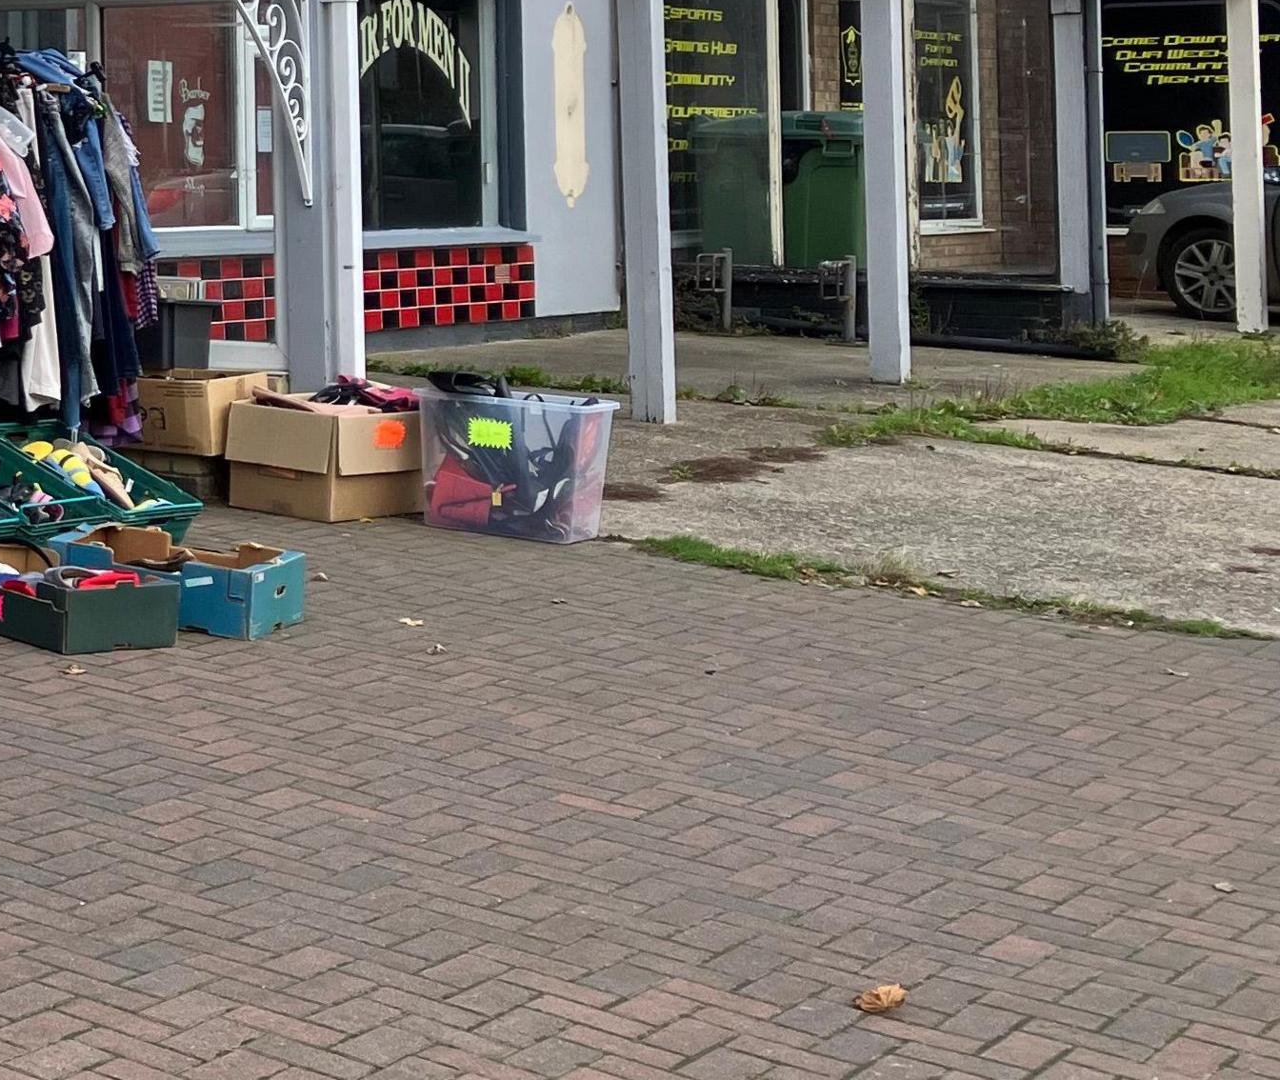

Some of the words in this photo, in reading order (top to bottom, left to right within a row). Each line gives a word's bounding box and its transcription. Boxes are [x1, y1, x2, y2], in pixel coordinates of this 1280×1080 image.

[416, 1, 456, 90] MEN
[458, 47, 472, 130] II
[1123, 61, 1230, 73] COMMUNI
[178, 76, 211, 104] Barber
